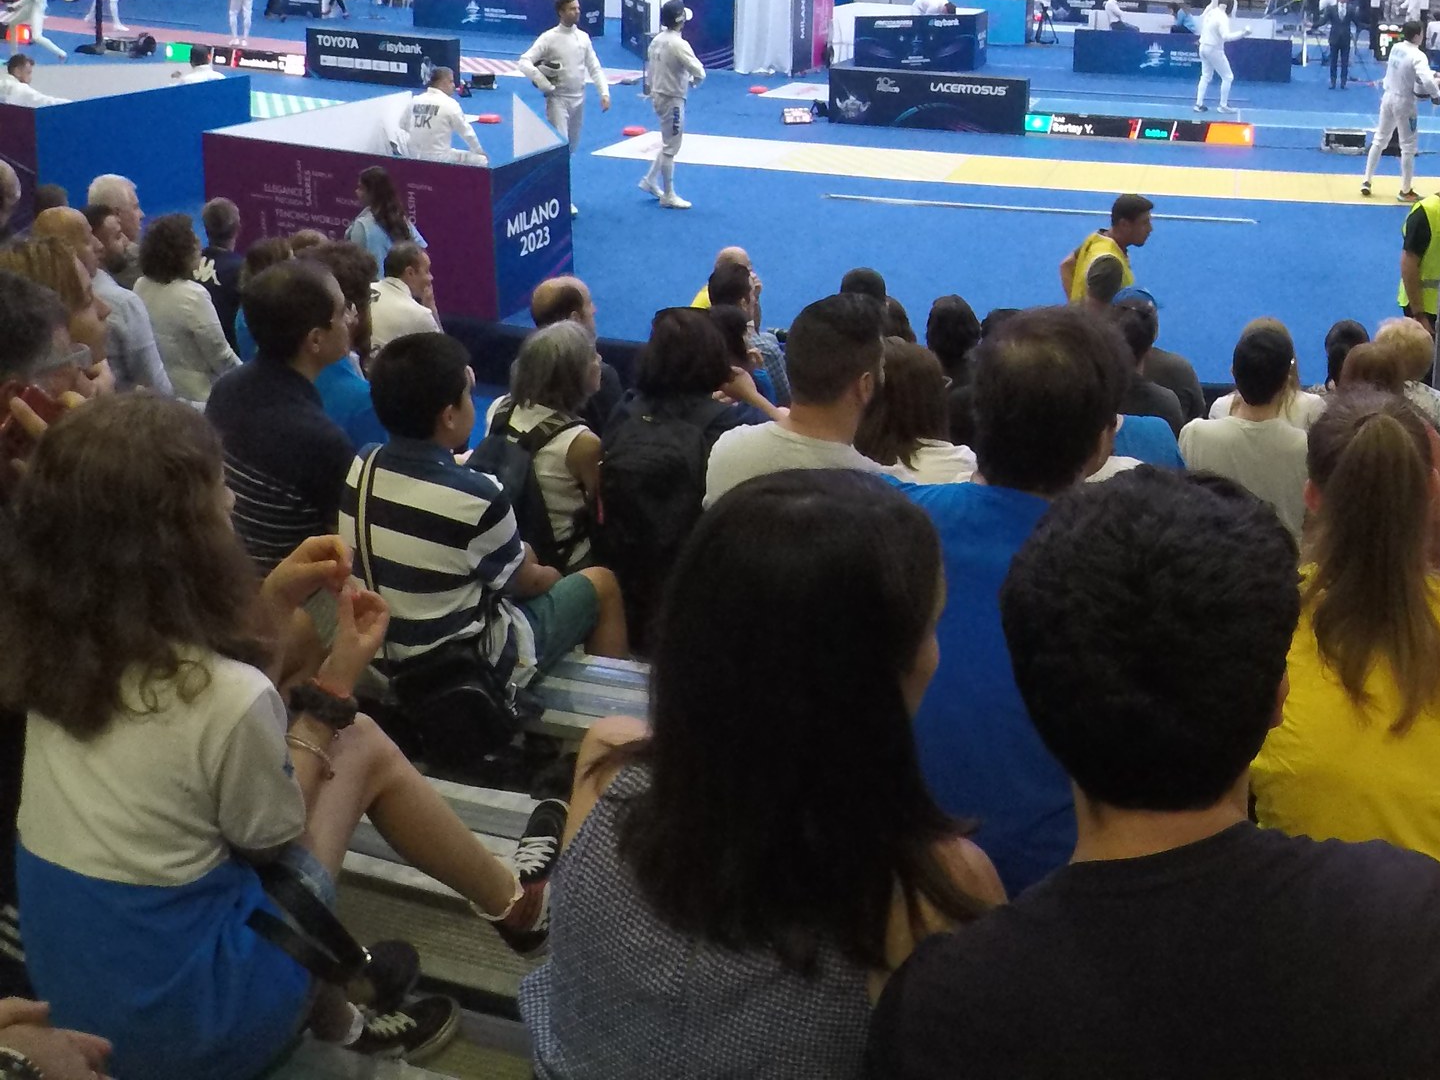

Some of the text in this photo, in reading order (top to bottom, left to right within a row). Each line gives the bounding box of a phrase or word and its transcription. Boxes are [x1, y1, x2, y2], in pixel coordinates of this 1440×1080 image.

[316, 34, 422, 55] TOYOTA isybank
[930, 81, 1006, 96] LACERTOSUS
[507, 197, 560, 238] MILANO
[520, 225, 551, 257] 2023
